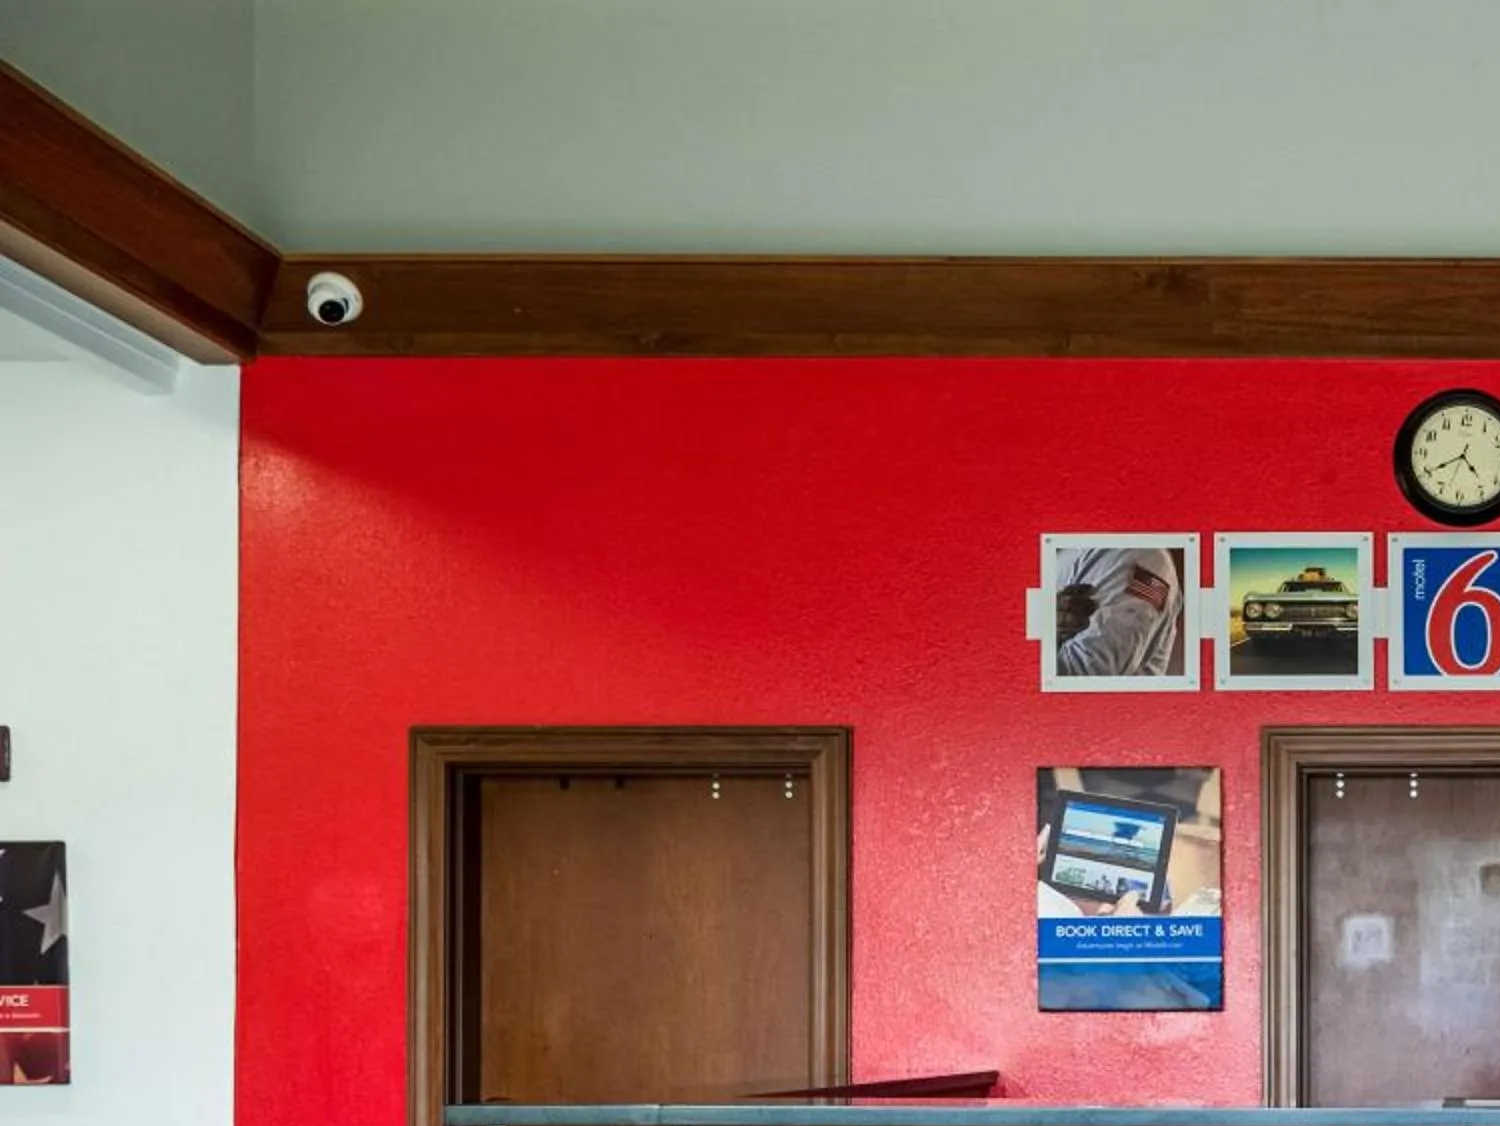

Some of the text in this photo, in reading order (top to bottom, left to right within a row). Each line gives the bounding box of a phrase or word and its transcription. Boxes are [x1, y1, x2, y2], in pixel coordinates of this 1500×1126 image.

[1412, 559, 1425, 600] motel
[1055, 923, 1203, 938] BOOK DIRECT & SAVE
